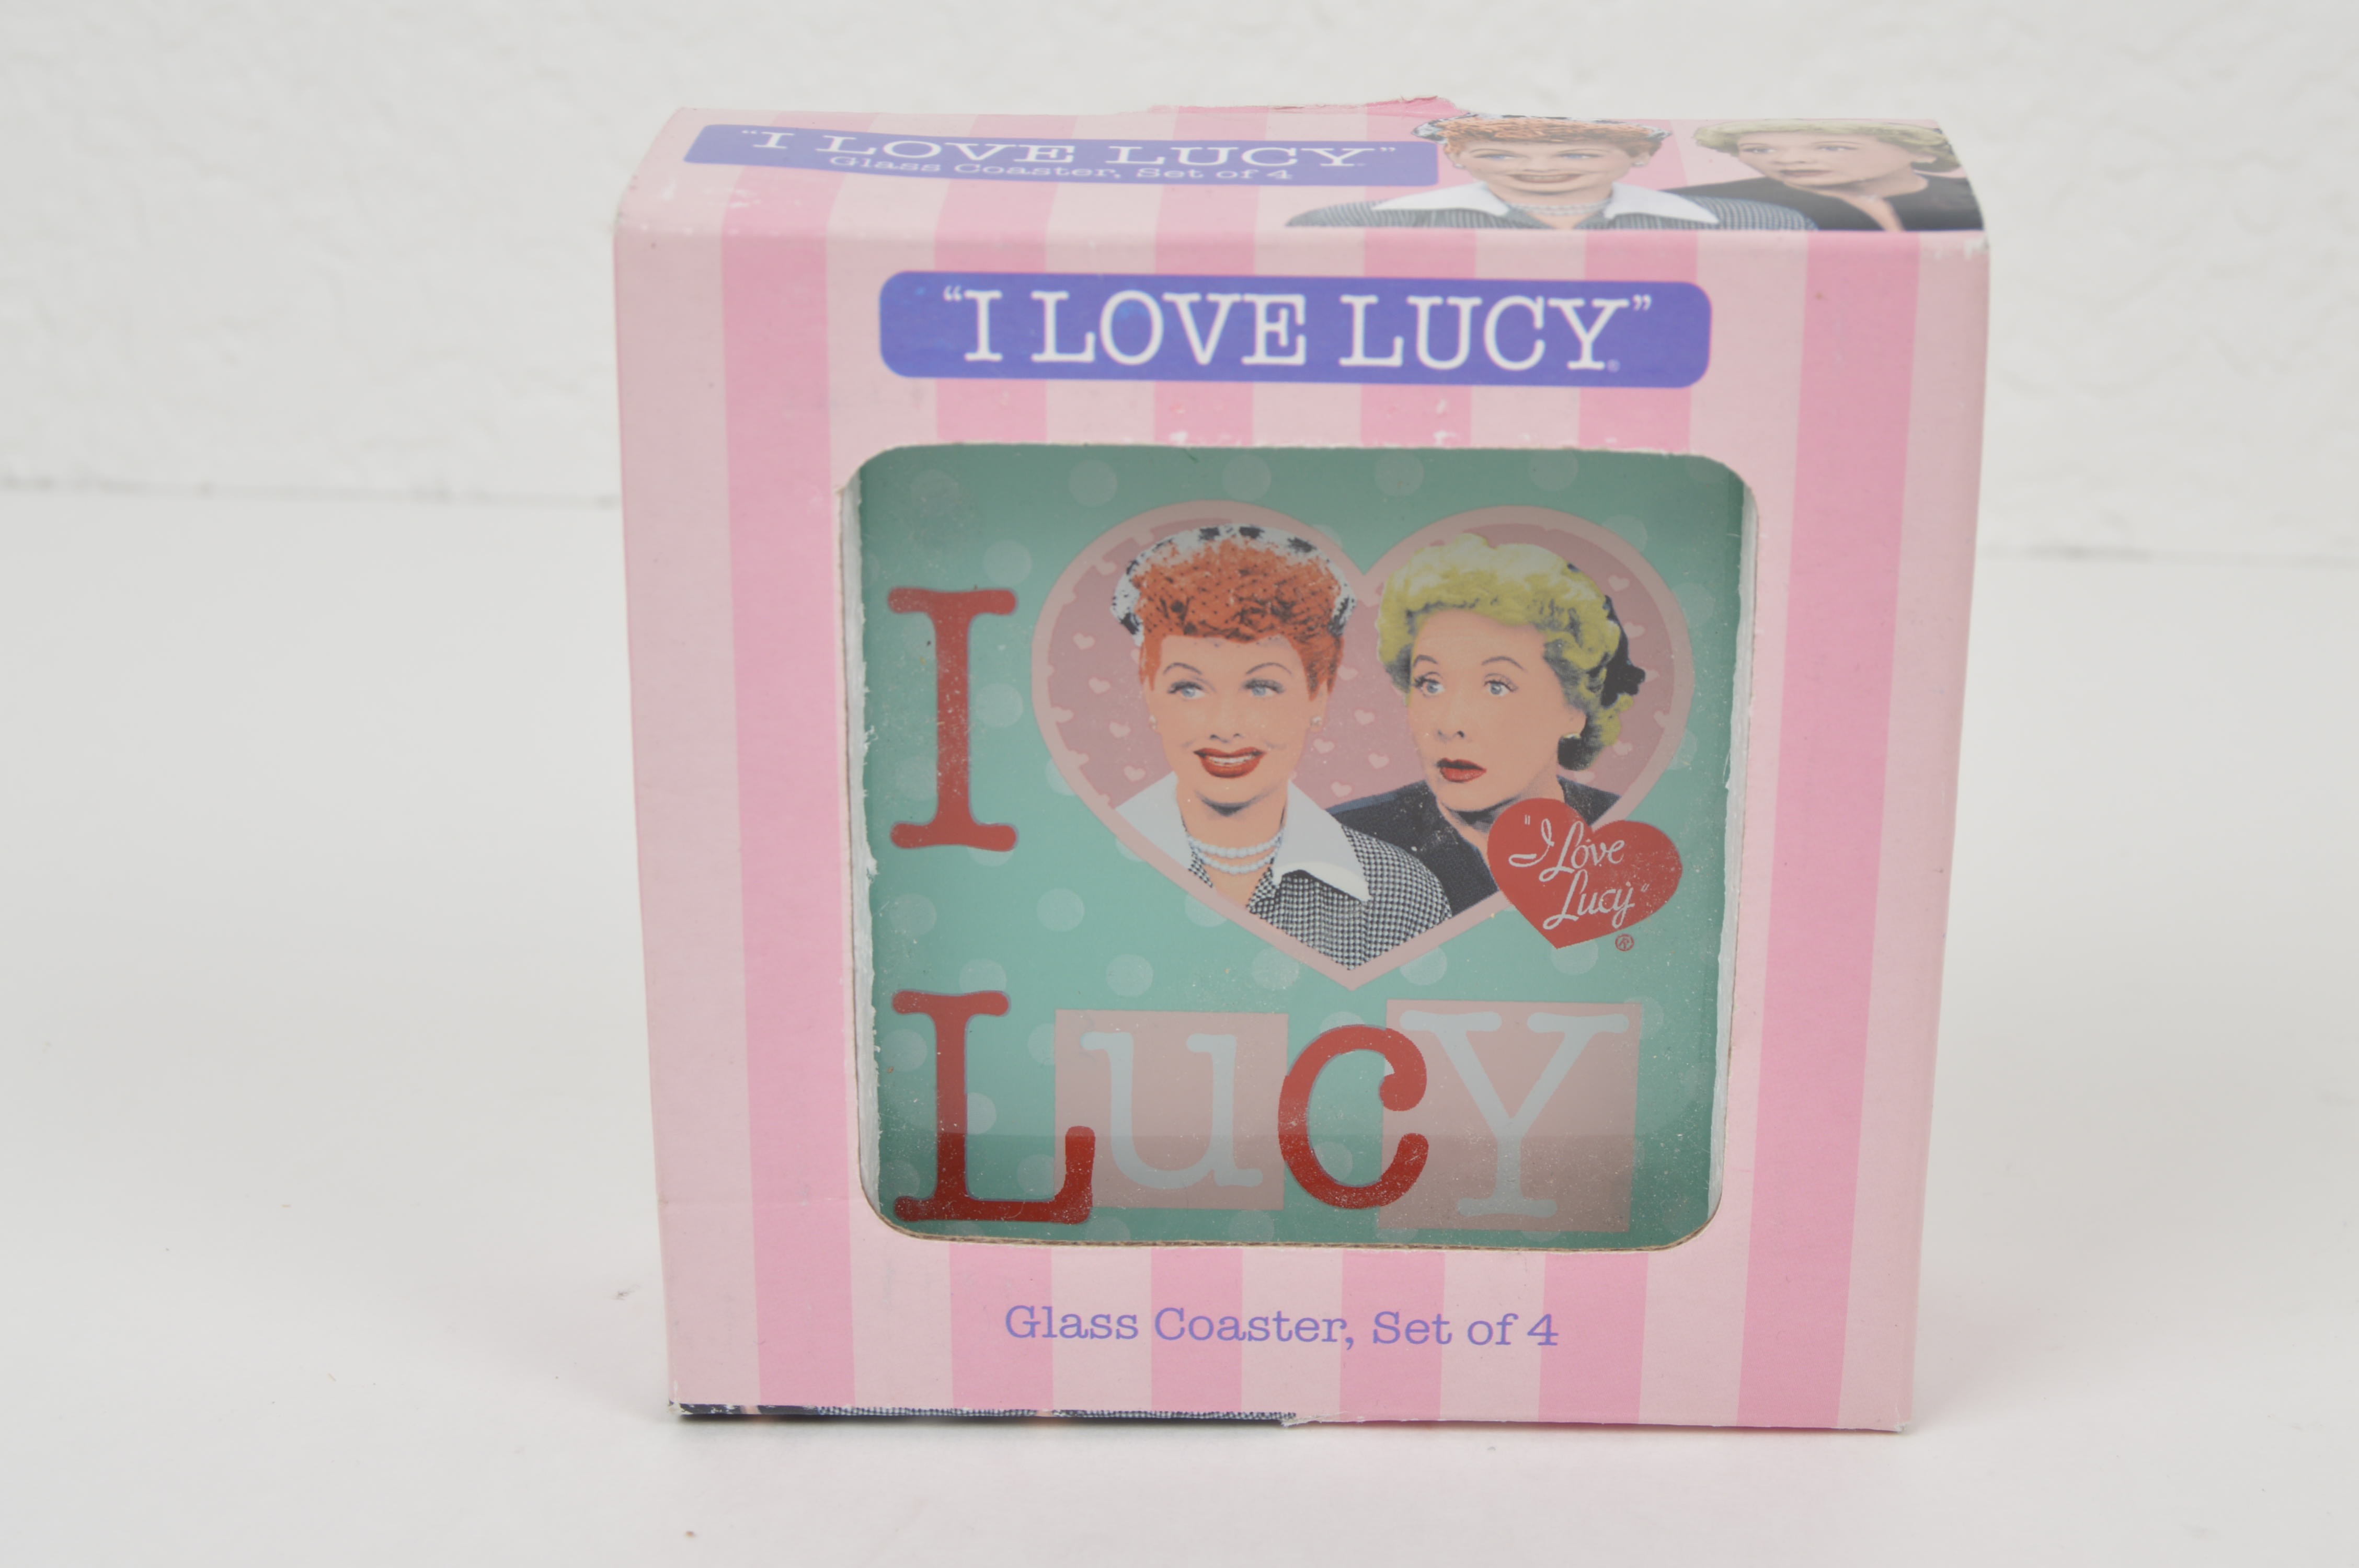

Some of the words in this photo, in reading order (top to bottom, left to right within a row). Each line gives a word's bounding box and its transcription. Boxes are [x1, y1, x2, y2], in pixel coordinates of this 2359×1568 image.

[816, 134, 1075, 164] LOVE
[829, 155, 942, 172] Glass
[954, 163, 1121, 180] Coaster,
[1137, 168, 1204, 180] Set
[1216, 169, 1259, 180] of
[1265, 169, 1293, 180] 4
[1032, 290, 1307, 365] LOVE
[887, 587, 1018, 852] I
[1539, 821, 1625, 882] Love
[1005, 1305, 1139, 1339] Glass
[1154, 1307, 1355, 1350] Coaster,
[1372, 1311, 1452, 1344] Set
[1467, 1313, 1518, 1345] of
[1527, 1315, 1559, 1346] 4
